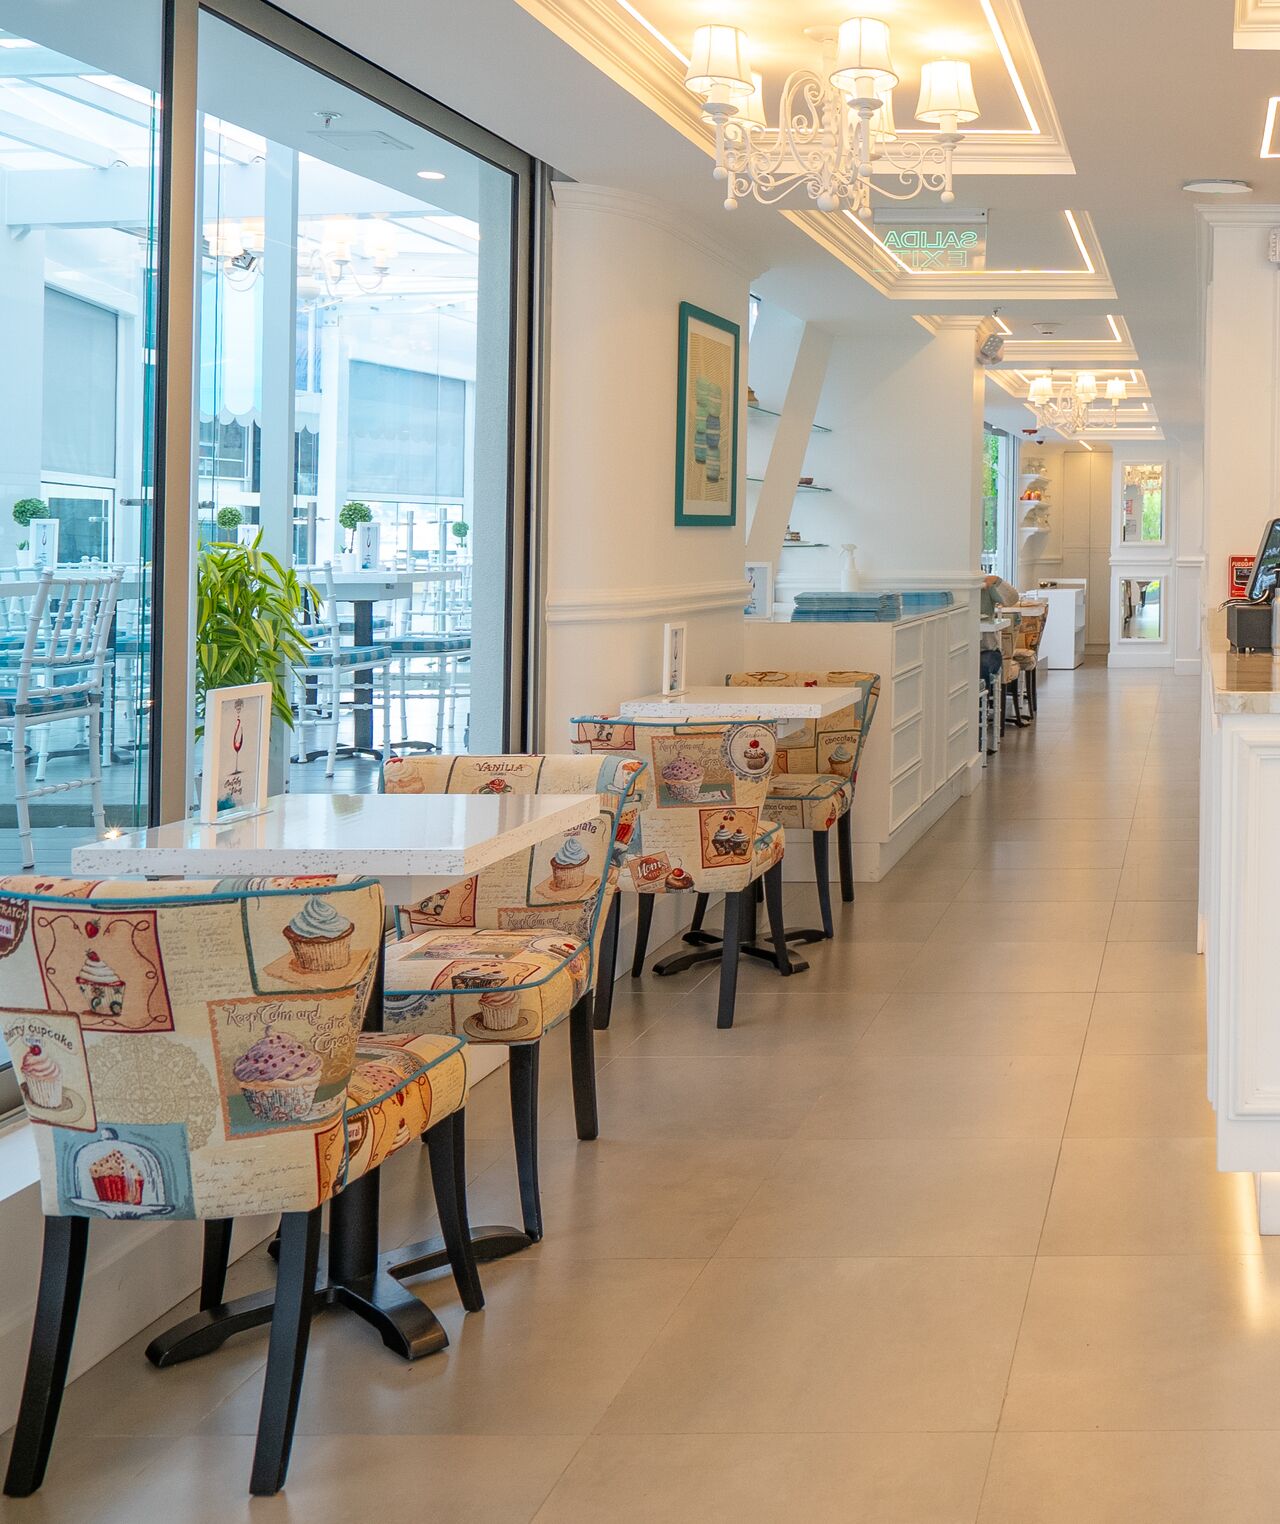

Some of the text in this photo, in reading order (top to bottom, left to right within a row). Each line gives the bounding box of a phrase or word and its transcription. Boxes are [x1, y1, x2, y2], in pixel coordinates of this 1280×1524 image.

[476, 761, 523, 772] VANILLA
[223, 1002, 321, 1032] Keep Calm and
[28, 1024, 73, 1050] cupcake
